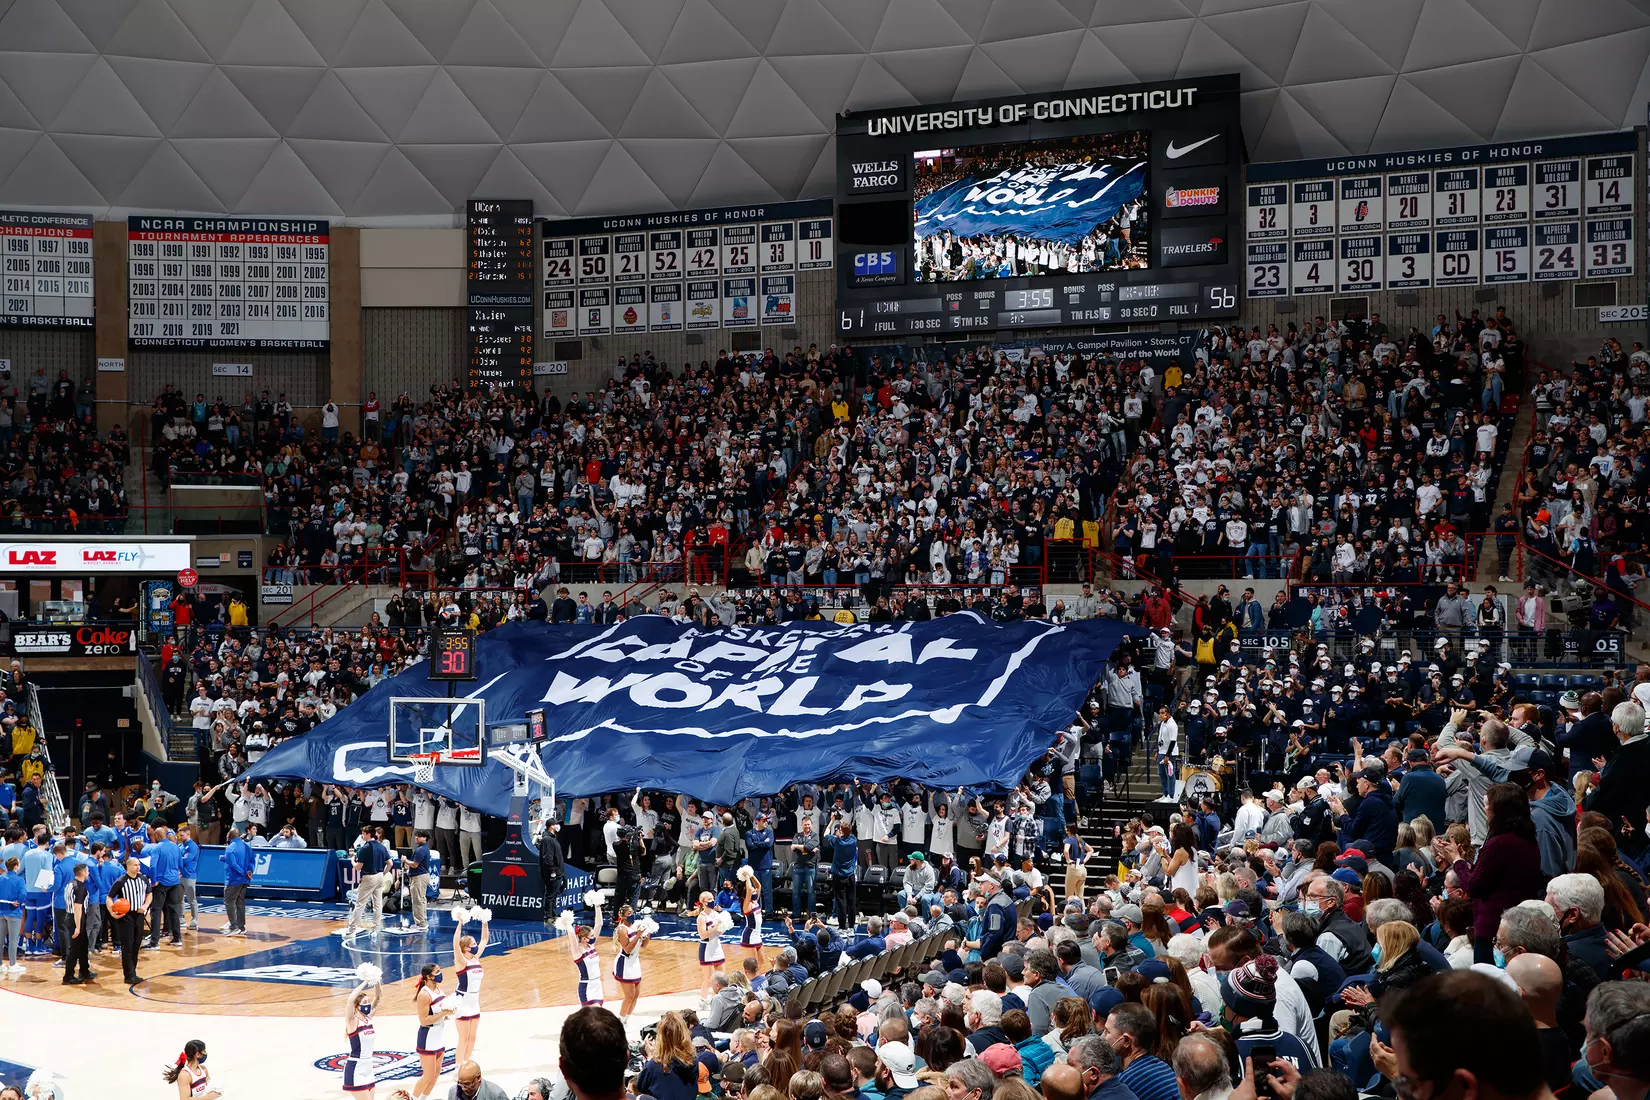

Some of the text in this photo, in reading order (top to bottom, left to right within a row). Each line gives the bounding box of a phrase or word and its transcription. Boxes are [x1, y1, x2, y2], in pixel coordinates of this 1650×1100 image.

[868, 87, 1197, 136] UNIVERSITY OF CONNECTICUT
[1327, 145, 1543, 171] UCONN HUSKIES OF HONOR
[852, 160, 898, 174] WELLS
[853, 175, 898, 188] FARGO
[1180, 187, 1219, 198] DUNKIN'
[1545, 184, 1566, 208] 31
[1597, 180, 1620, 204] 14
[1179, 195, 1219, 207] DONUTS
[1399, 196, 1418, 219] 20
[1448, 192, 1465, 215] 31
[1496, 188, 1516, 212] 23
[32, 216, 89, 226] CONFERENCE
[603, 208, 765, 229] UCONN HUSKIES OF HONOR
[1259, 207, 1276, 229] 32
[1309, 204, 1318, 225] 3
[141, 219, 317, 233] NCAA CHAMPIONSHIP
[140, 232, 319, 243] TOURNAMENT APPEARANCES
[8, 239, 89, 254] 1996 1997 1998
[133, 244, 325, 260] 1989 1990 1991 1992 1993 1994 1995
[770, 243, 785, 263] 33
[809, 240, 822, 260] 10
[1163, 243, 1212, 256] TRAVELERS
[655, 251, 677, 271] 52
[691, 248, 715, 268] 42
[730, 246, 749, 266] 25
[1495, 249, 1517, 272] 15
[1539, 246, 1574, 270] 24
[1593, 243, 1627, 266] 33
[7, 259, 90, 274] 2005 2006 2008
[133, 263, 326, 279] 1996 1997 1998 1999 2000 2001 2002
[547, 259, 571, 278] 24
[582, 256, 606, 276] 50
[620, 254, 639, 273] 21
[1347, 259, 1373, 282] 30
[1402, 256, 1415, 279] 3
[1442, 253, 1470, 276] CD
[1253, 265, 1280, 287] 23
[1306, 262, 1320, 284] 4
[7, 279, 89, 294] 2014 2015 2016
[133, 283, 326, 299] 2003 2004 2005 2006 2007 2008 2009
[1063, 285, 1085, 294] BONUS
[1097, 284, 1115, 292] POSS
[946, 293, 963, 301] POSS
[974, 291, 995, 300] BONUS
[1018, 290, 1051, 308] 3:55
[8, 299, 28, 312] 2021
[133, 303, 325, 318] 2010 2011 2012 2013 2014 2015 2016
[1120, 306, 1149, 318] 30 SEC
[1169, 304, 1189, 315] FULL
[1600, 307, 1647, 318] SEC 205
[22, 317, 93, 326] BASKETBALL
[961, 316, 988, 326] TM FLS
[1071, 309, 1099, 320] TM FLS
[134, 323, 239, 336] 2017 2018 2019 2021
[878, 321, 896, 331] FULL
[914, 319, 941, 329] 30 SEC
[135, 338, 325, 349] CONNECTICUT WOMEN'S BASKETBALL
[1042, 343, 1064, 353] Harry
[1077, 338, 1108, 350] Gampel
[1110, 337, 1142, 348] Pavilion
[1150, 336, 1177, 346] Storrs,
[1179, 336, 1191, 345] CT
[1128, 350, 1137, 358] of
[1138, 349, 1152, 358] the
[1153, 348, 1180, 358] World
[237, 365, 250, 374] 14
[549, 363, 568, 372] 201
[9, 550, 138, 565] LAZ LAZ FLY
[276, 586, 292, 594] 201
[14, 633, 71, 646] BEAR'S
[76, 627, 128, 645] Coke
[446, 637, 468, 650] 3:55
[1262, 636, 1289, 647] 105
[85, 645, 120, 654] zero
[442, 651, 465, 673] 30
[250, 808, 259, 817] 34
[397, 805, 407, 816] 34
[481, 892, 542, 909] TRAVELERS
